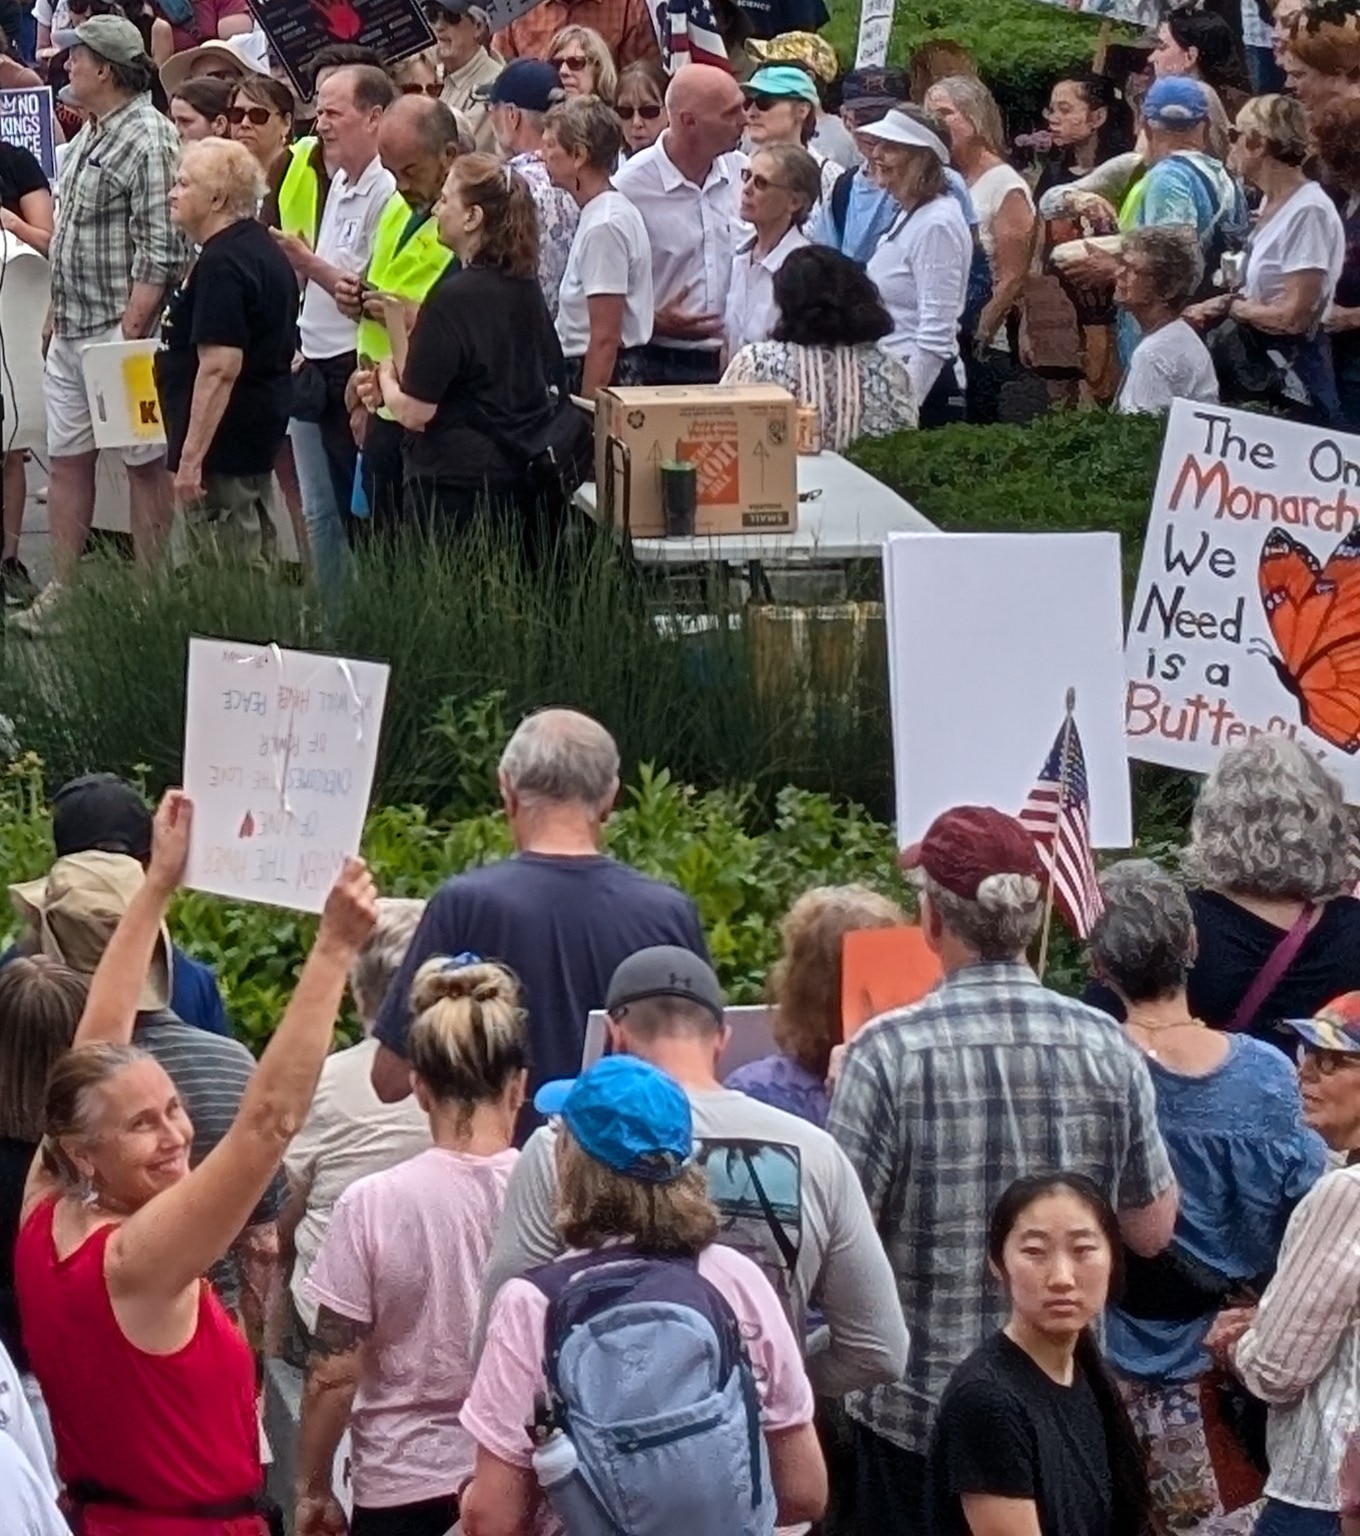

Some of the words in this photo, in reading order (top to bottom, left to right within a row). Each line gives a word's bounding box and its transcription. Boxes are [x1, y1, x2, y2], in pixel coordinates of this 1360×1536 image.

[1, 116, 41, 134] KINGS
[16, 95, 40, 114] NO
[1193, 411, 1277, 469] The
[1168, 453, 1360, 534] Monarch
[1164, 523, 1236, 578] We
[1137, 581, 1245, 644] Need
[1146, 647, 1187, 682] is
[1205, 662, 1230, 687] a
[221, 690, 266, 715] PEACE
